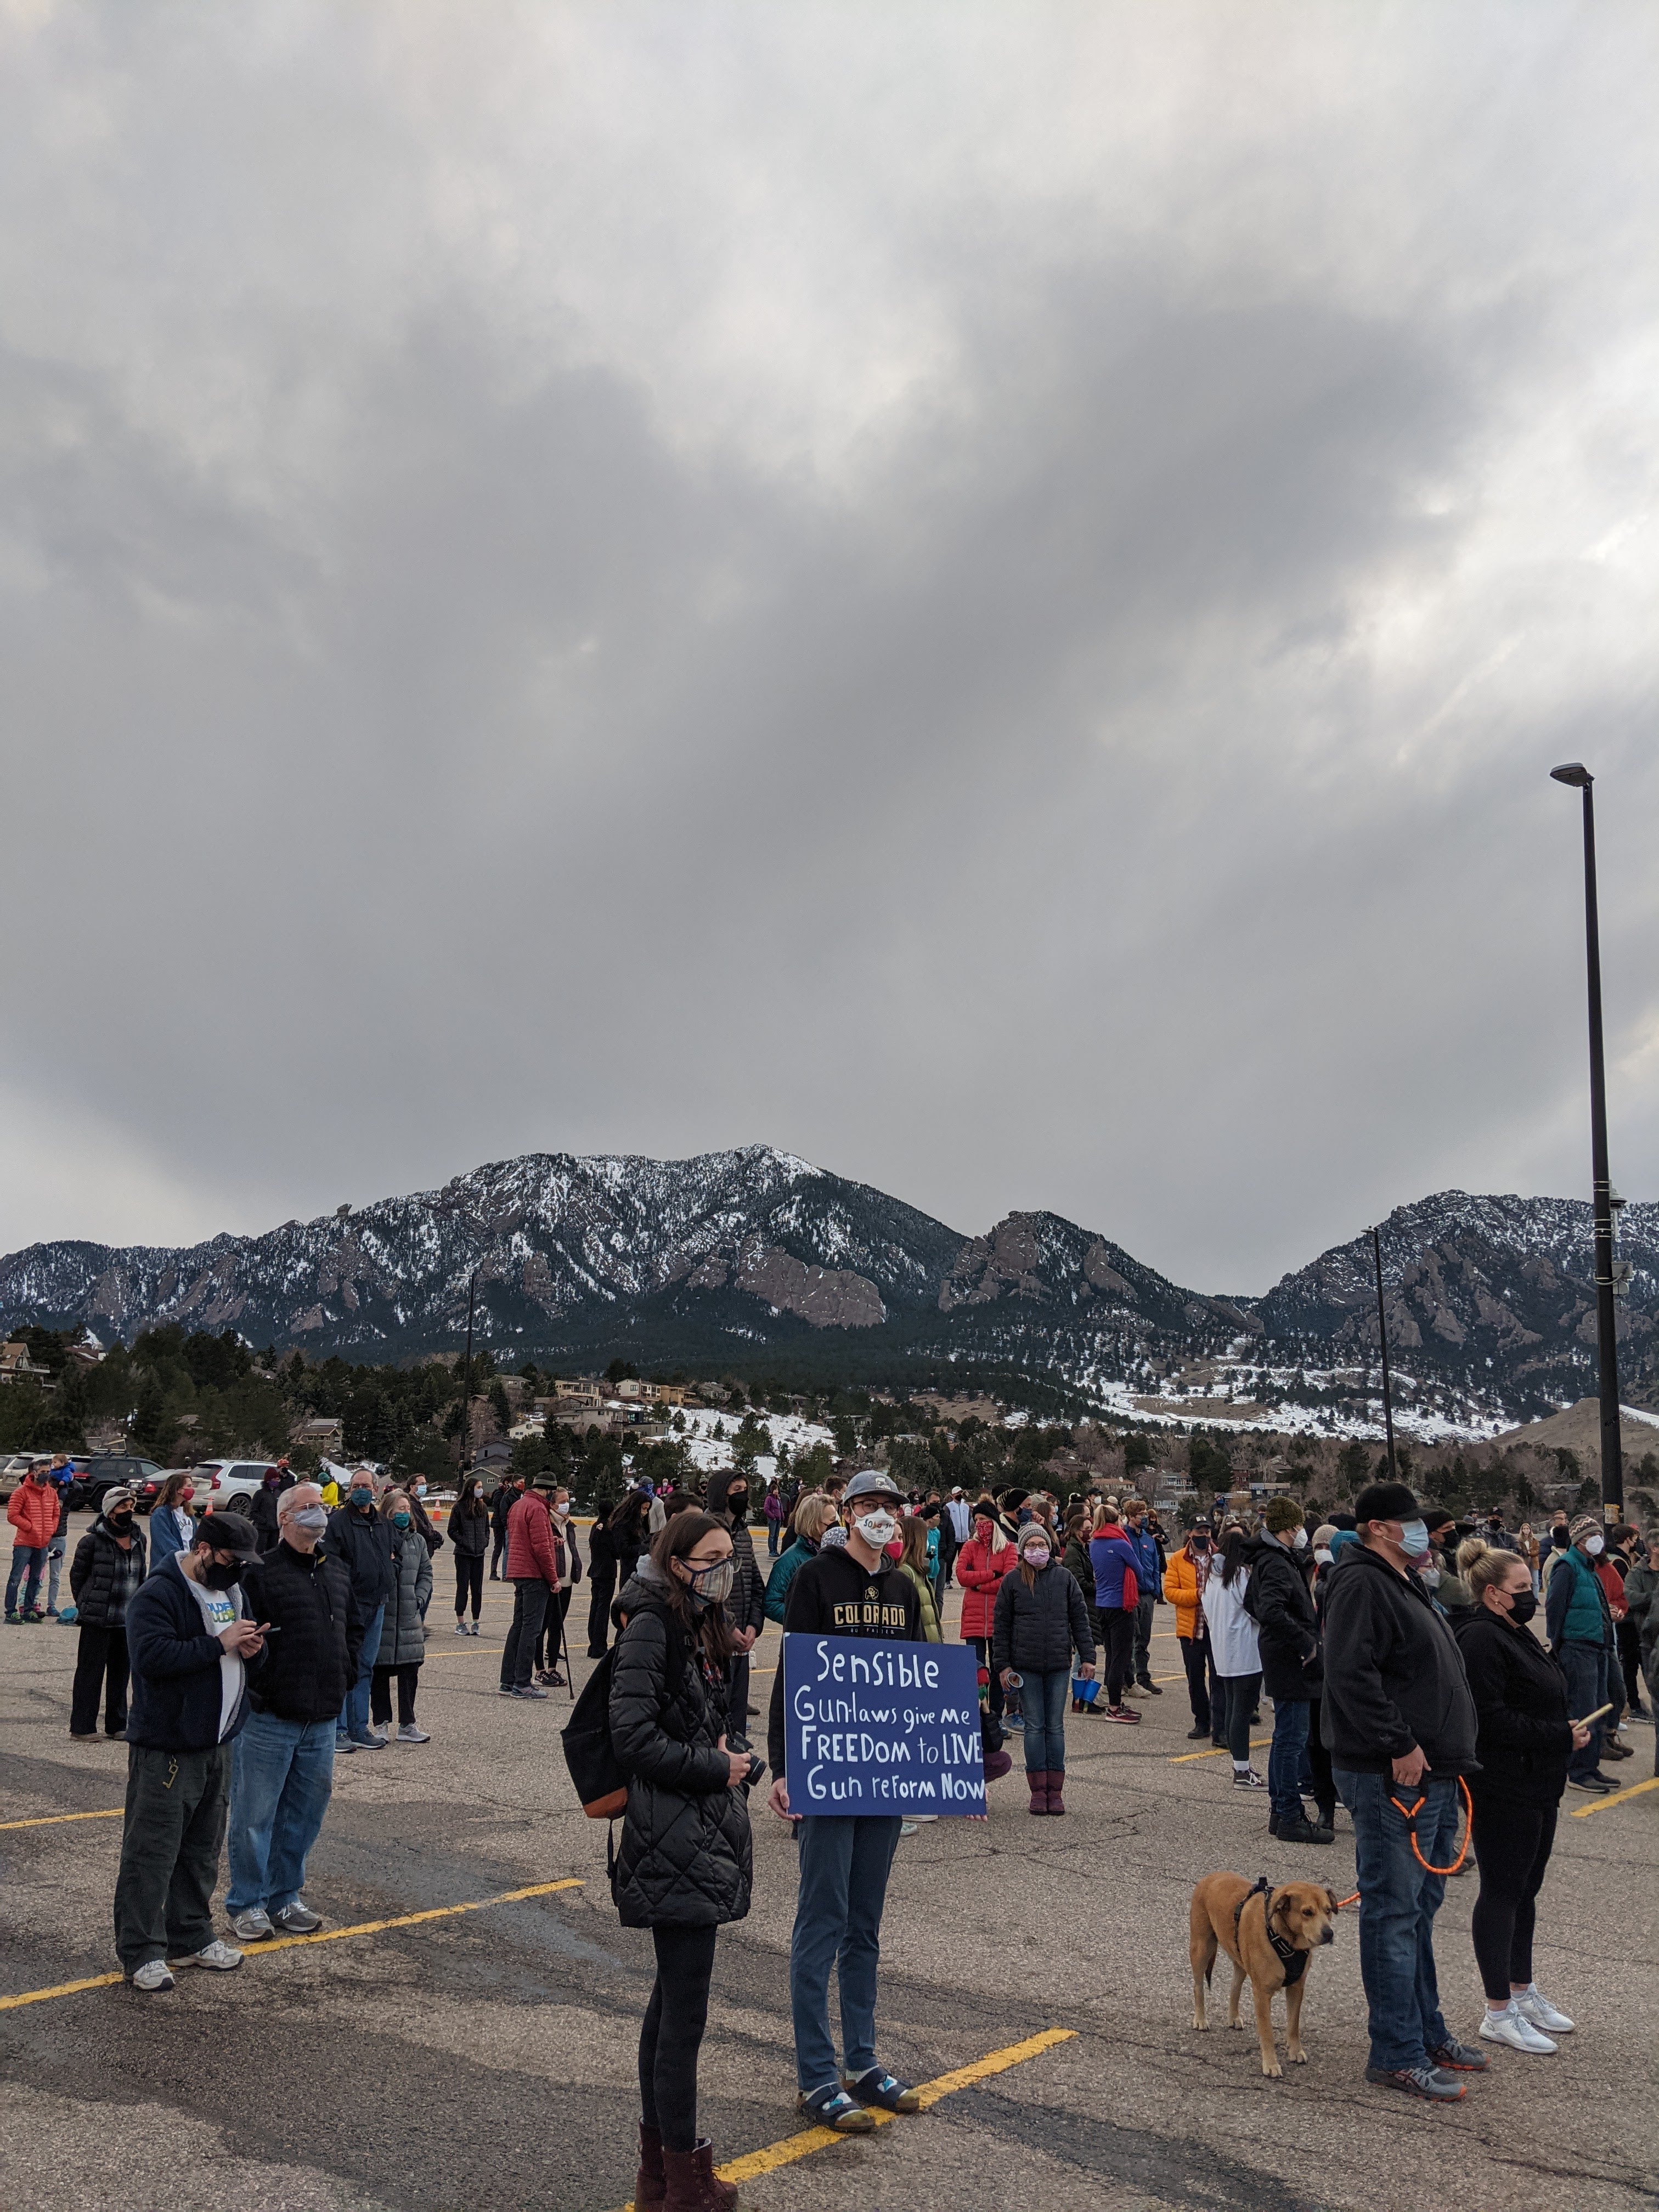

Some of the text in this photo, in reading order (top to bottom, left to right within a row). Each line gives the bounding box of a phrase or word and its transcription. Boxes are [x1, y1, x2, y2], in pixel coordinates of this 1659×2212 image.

[834, 1605, 905, 1627] COLORADO
[816, 1640, 939, 1688] Sensible
[903, 1707, 935, 1734] give
[917, 1737, 939, 1764] to
[943, 1732, 984, 1764] LIVE
[807, 1764, 862, 1800] Gun
